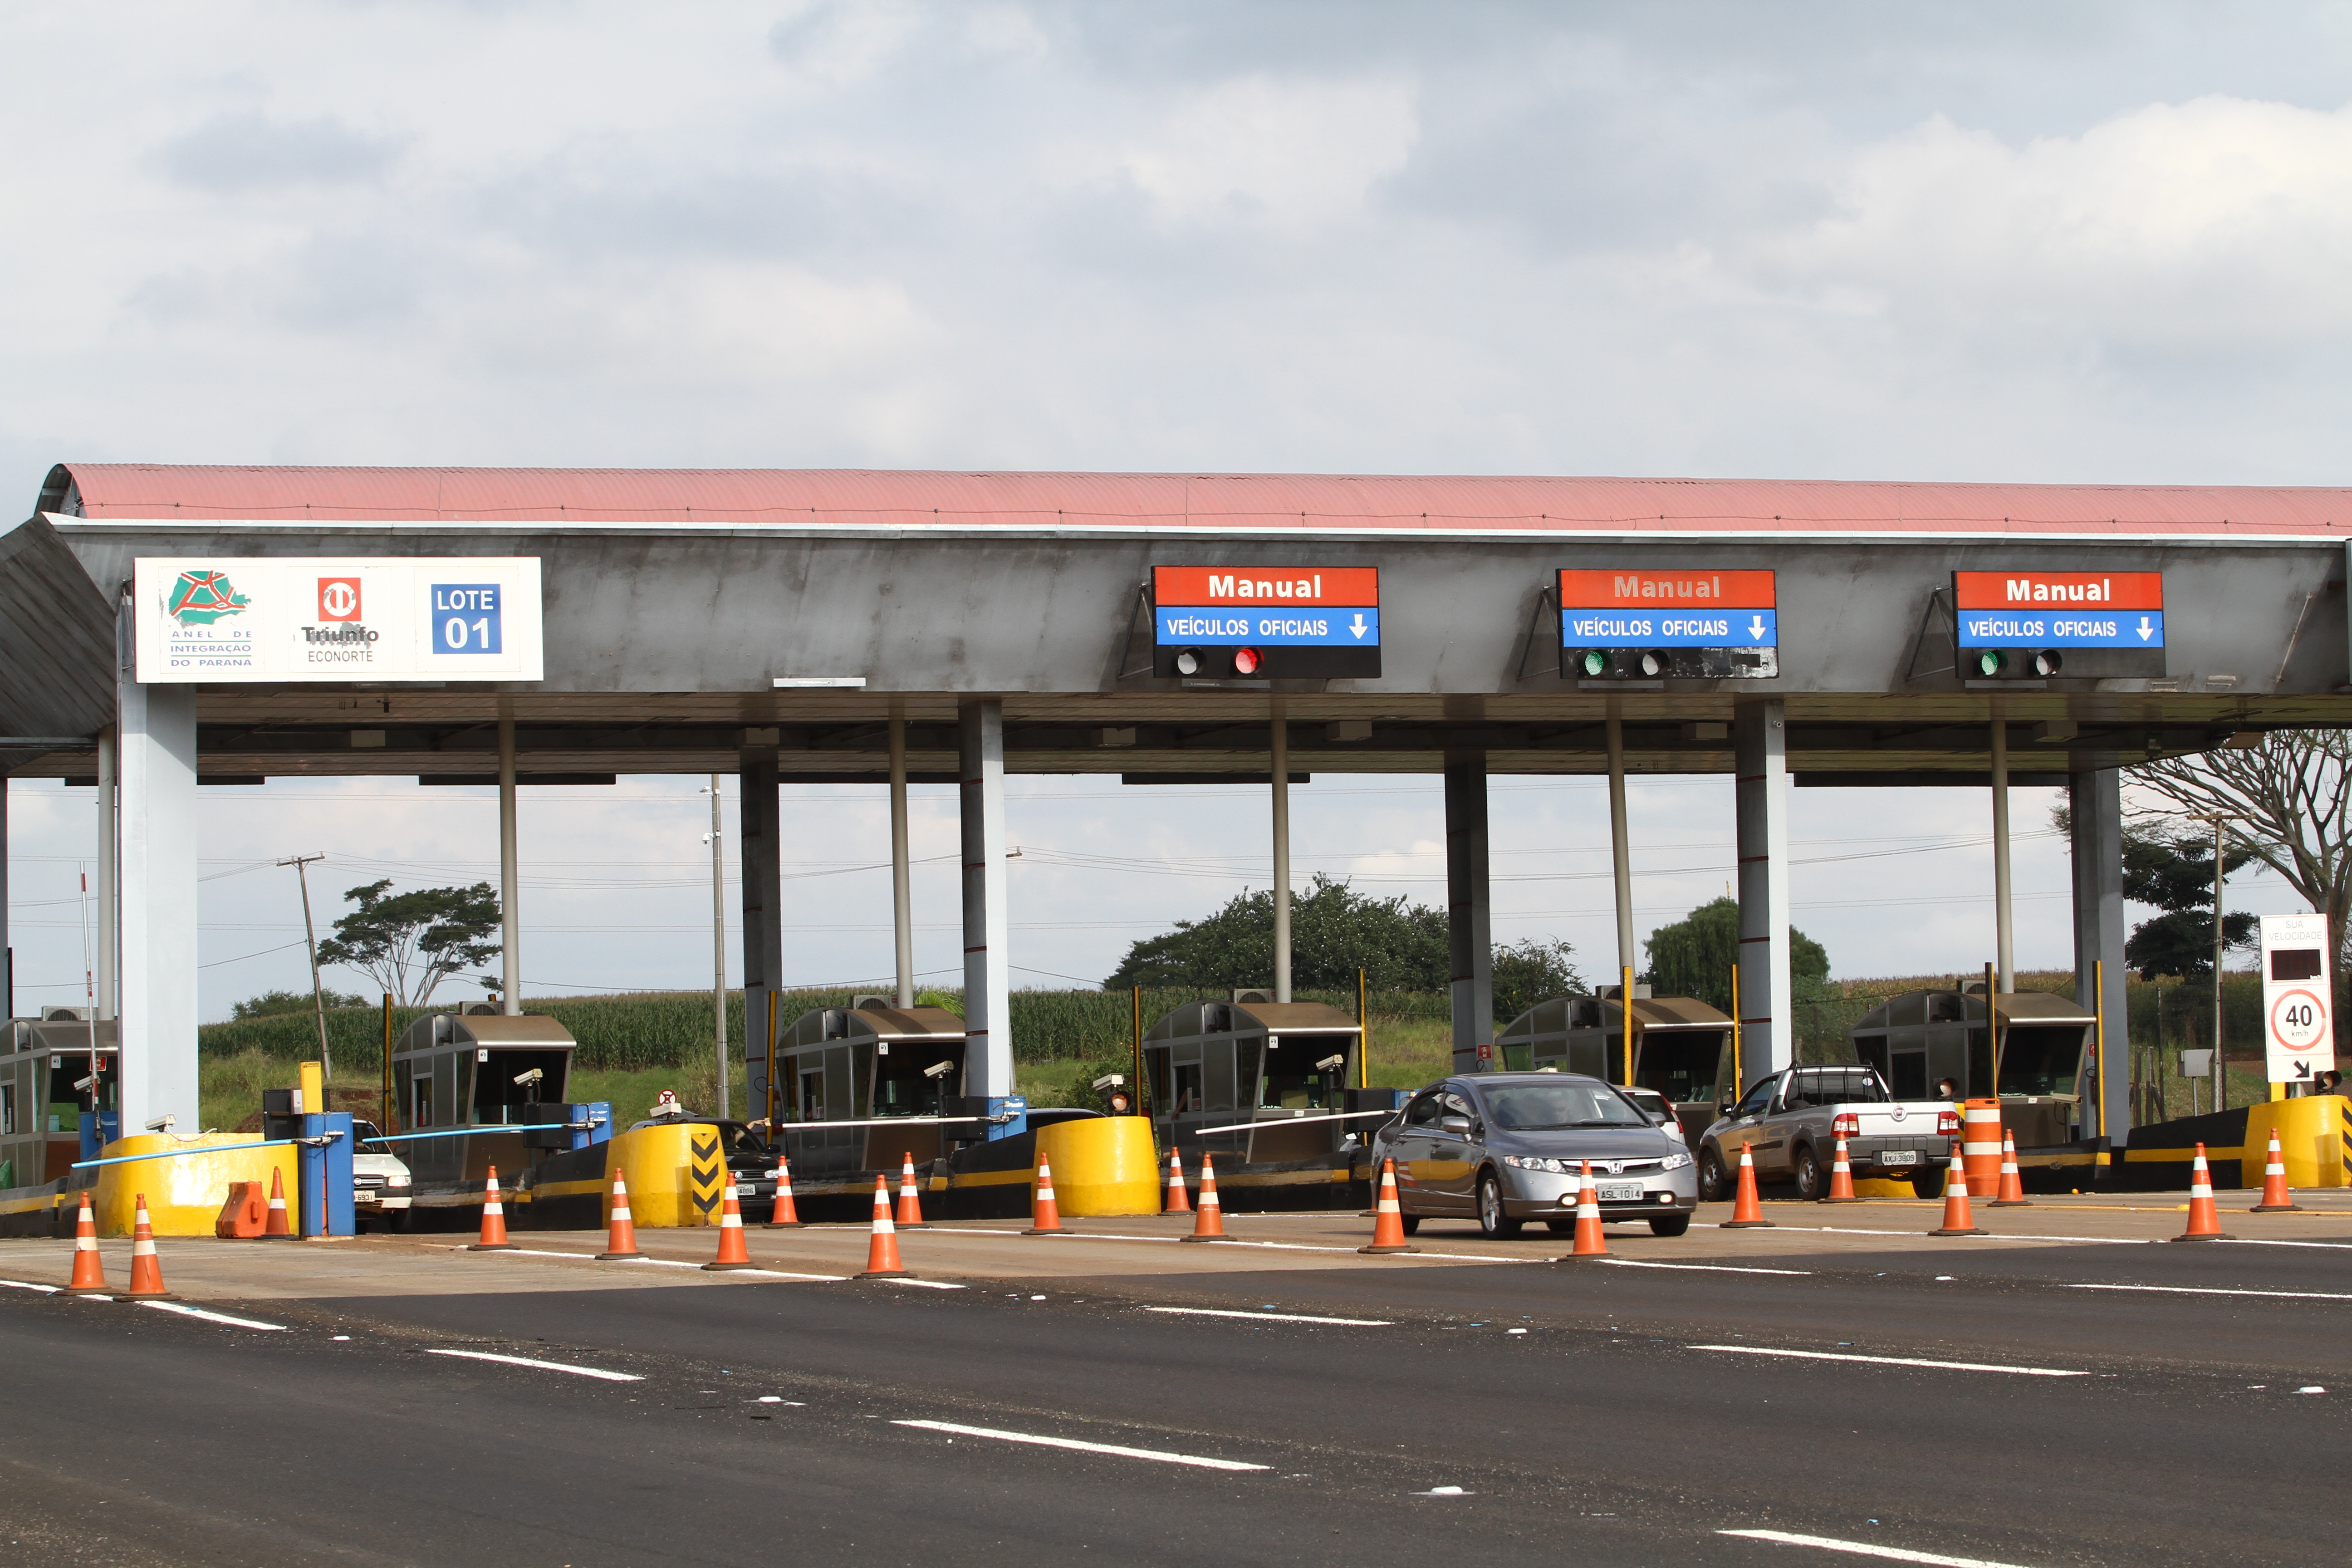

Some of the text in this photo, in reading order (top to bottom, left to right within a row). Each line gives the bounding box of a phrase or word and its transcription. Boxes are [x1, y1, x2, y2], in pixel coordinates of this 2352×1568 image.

[1209, 574, 1321, 598] Manual
[1614, 576, 1720, 598] Manual
[2006, 578, 2110, 602] Manual
[437, 589, 494, 610] LOTE
[301, 626, 379, 642] Triunfo
[445, 617, 489, 649] 01
[1167, 615, 1328, 636] VEÍCULOS OFICIAIS
[1573, 617, 1728, 636] VEÍCULOS OFICIAIS
[1968, 617, 2117, 637] VEÍCULOS OFICIAIS
[171, 643, 251, 654] INTEGRAÇÃO
[308, 651, 373, 662] ECONORTE
[199, 658, 252, 666] PARANÁ
[2285, 921, 2304, 929] SUA
[2268, 931, 2323, 941] VELOCIDADE
[2285, 1004, 2313, 1027] 40
